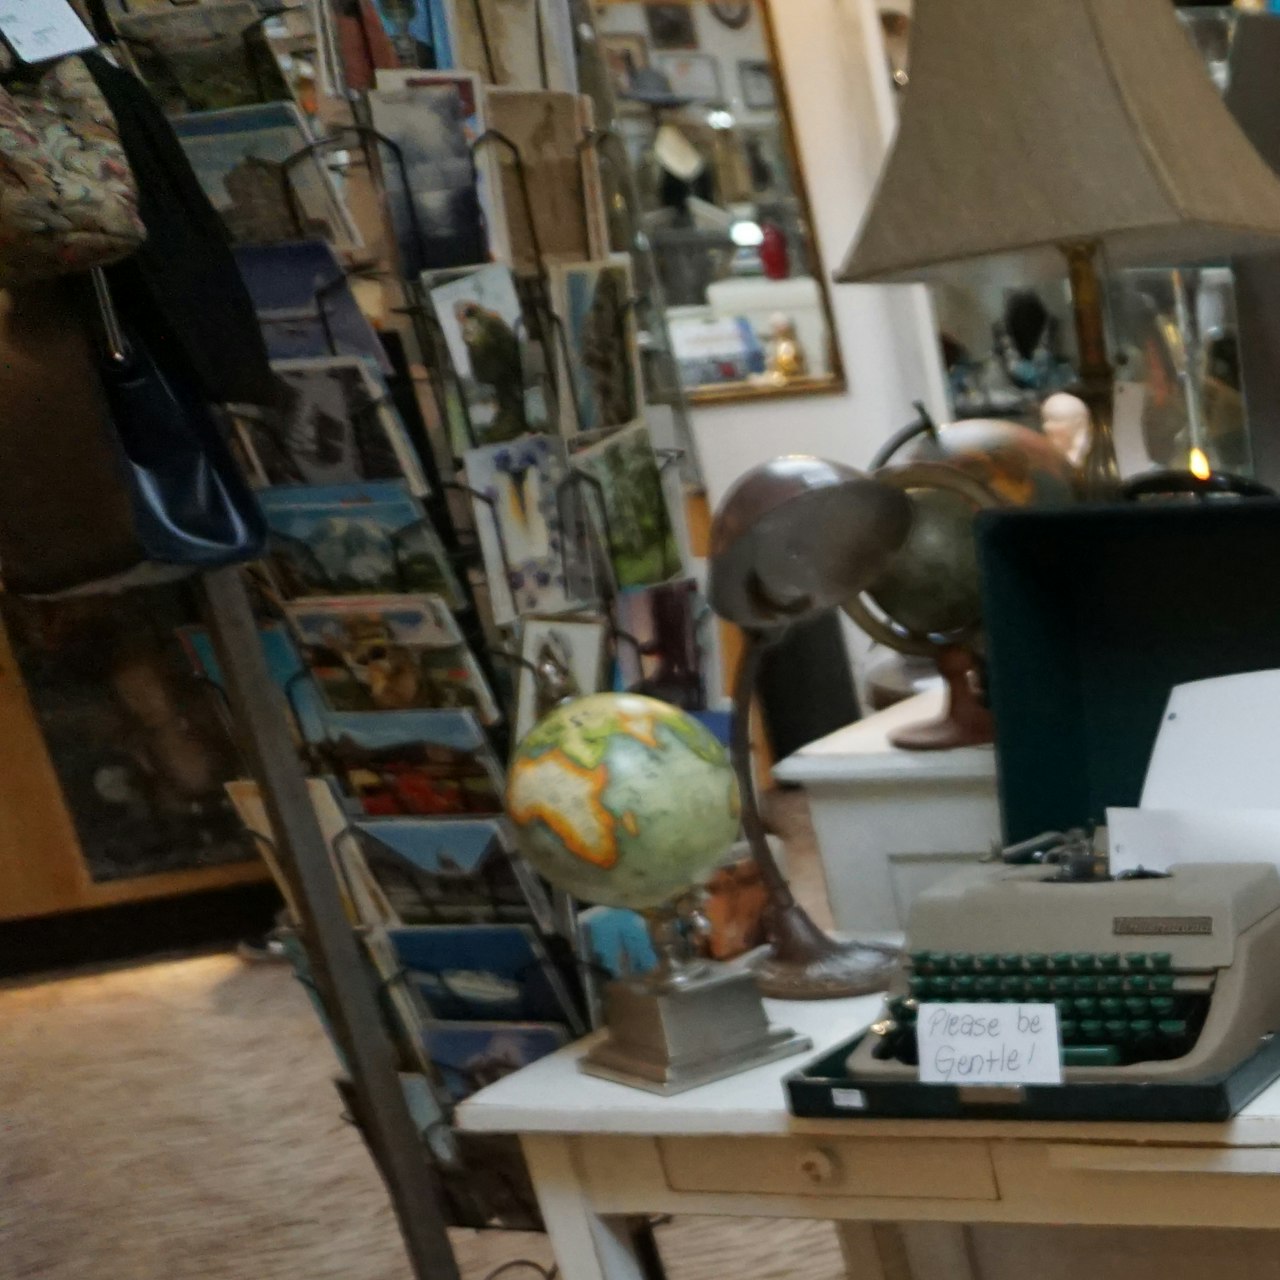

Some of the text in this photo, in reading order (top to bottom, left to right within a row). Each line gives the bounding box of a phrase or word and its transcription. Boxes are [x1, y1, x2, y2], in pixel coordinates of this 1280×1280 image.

[929, 1007, 1042, 1038] Please be
[935, 1042, 1036, 1080] Gentle!
